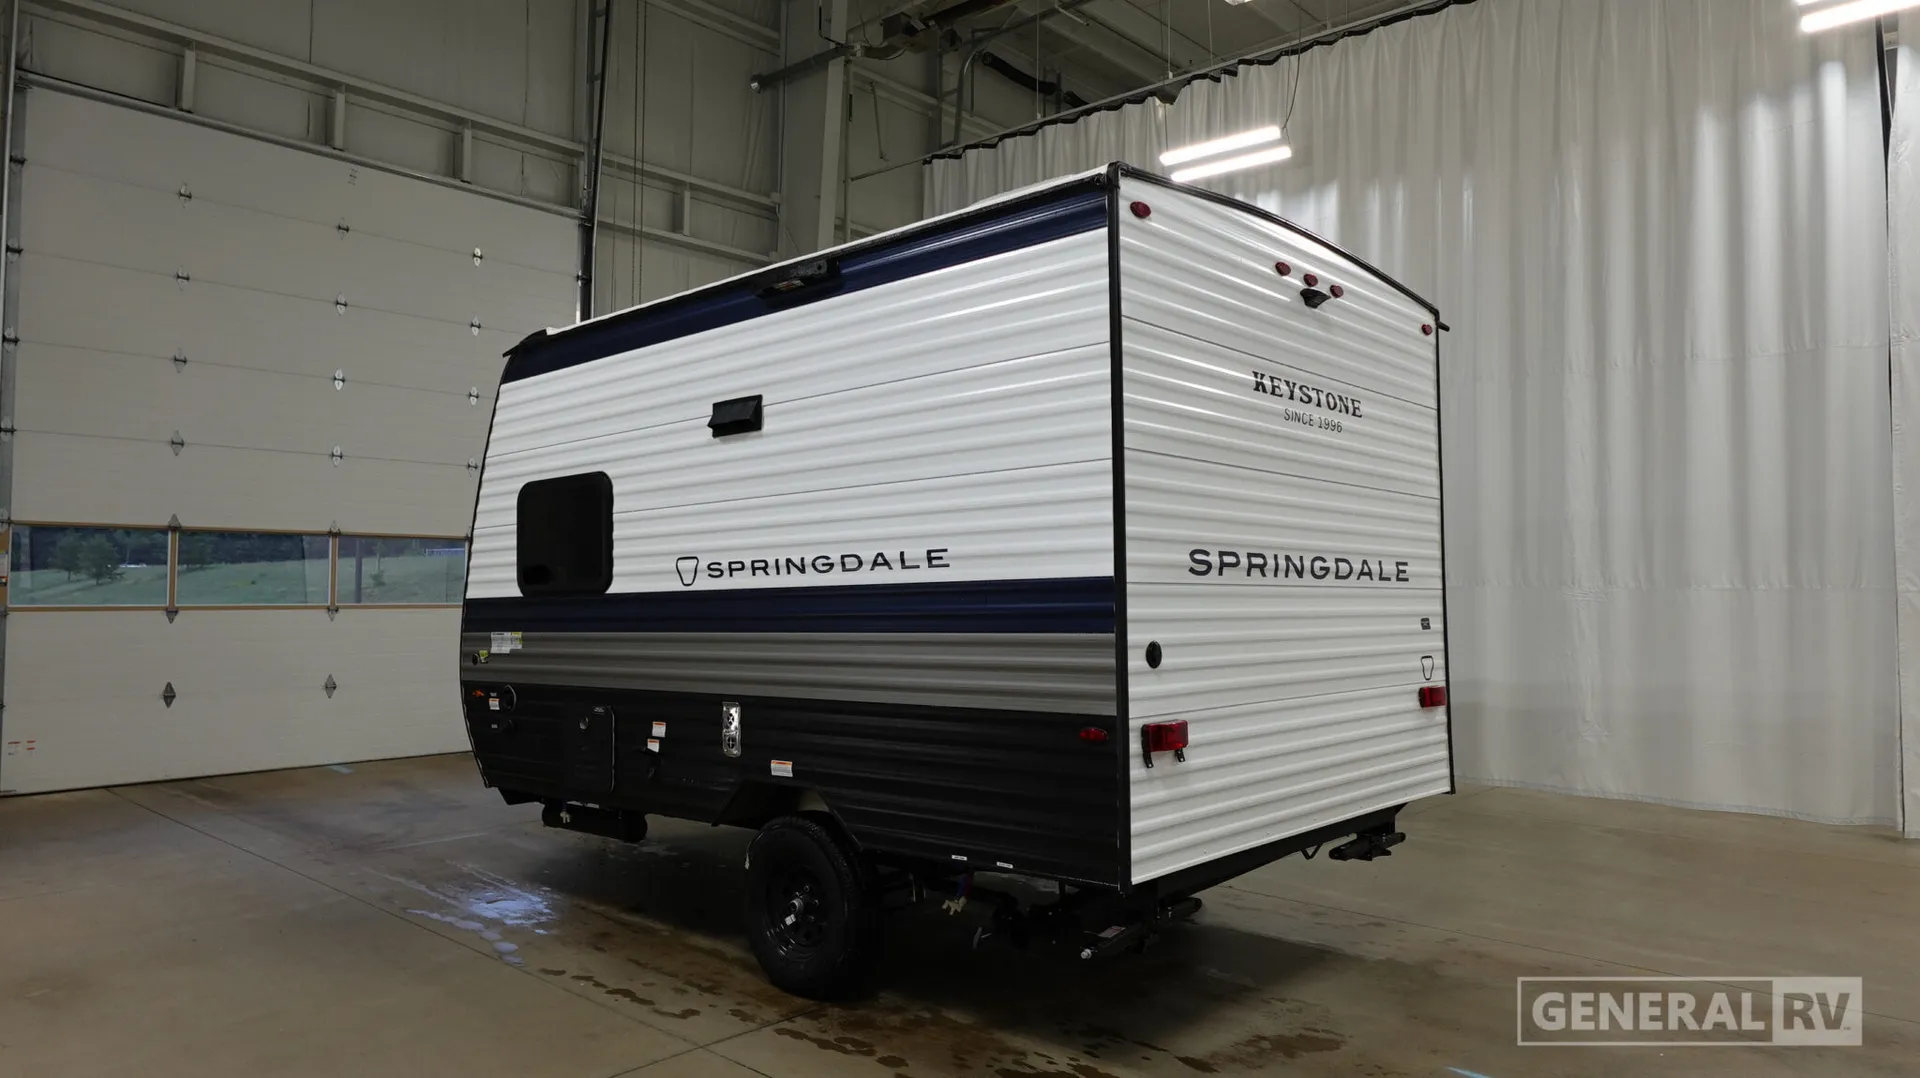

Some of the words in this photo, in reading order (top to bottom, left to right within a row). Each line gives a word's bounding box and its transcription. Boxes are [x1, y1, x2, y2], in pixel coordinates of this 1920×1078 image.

[1252, 371, 1363, 418] KEYSTONE
[1284, 408, 1315, 428] SINCE
[1318, 416, 1343, 433] 1996
[707, 548, 951, 579] SPRINGDALE
[1188, 548, 1410, 582] SPRINGDALE
